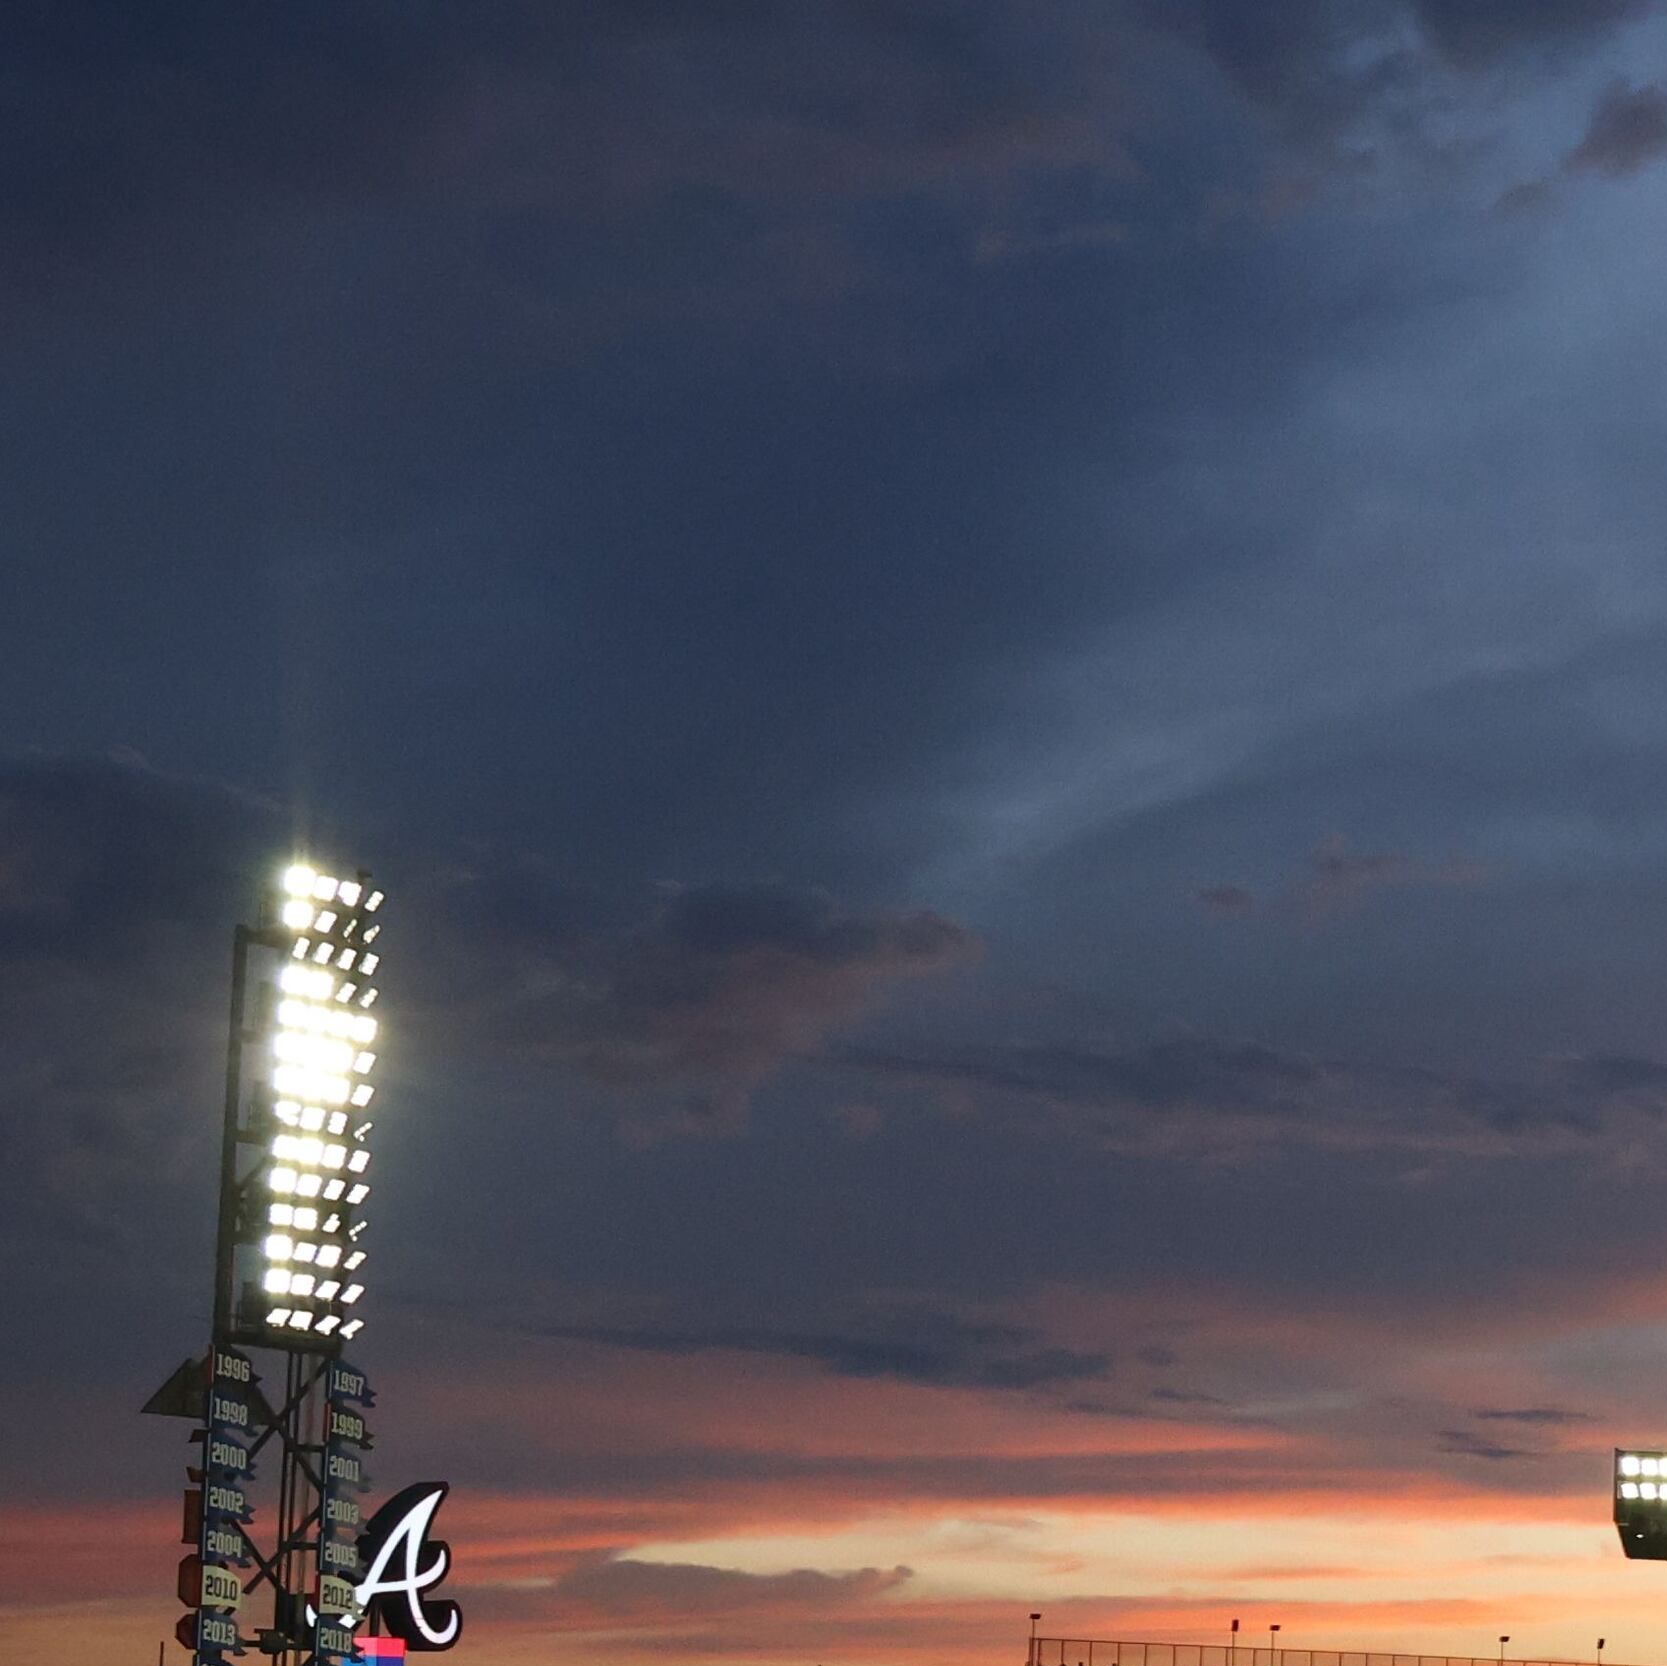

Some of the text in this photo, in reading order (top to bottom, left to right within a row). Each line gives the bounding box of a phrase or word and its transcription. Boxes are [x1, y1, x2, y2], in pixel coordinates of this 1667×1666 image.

[215, 1352, 250, 1382] 1996
[333, 1369, 364, 1396] 1997
[213, 1397, 248, 1426] 1998
[330, 1411, 363, 1440] 1999
[211, 1441, 247, 1470] 2000
[328, 1454, 360, 1482] 2001
[208, 1485, 244, 1514] 2002
[326, 1497, 359, 1526] 2003
[206, 1530, 242, 1558] 2004
[324, 1540, 358, 1568] 2005
[305, 1488, 459, 1645] A
[205, 1573, 239, 1602] 2010
[322, 1581, 354, 1608] 2012
[202, 1618, 236, 1646] 2013
[319, 1626, 352, 1653] 2018
